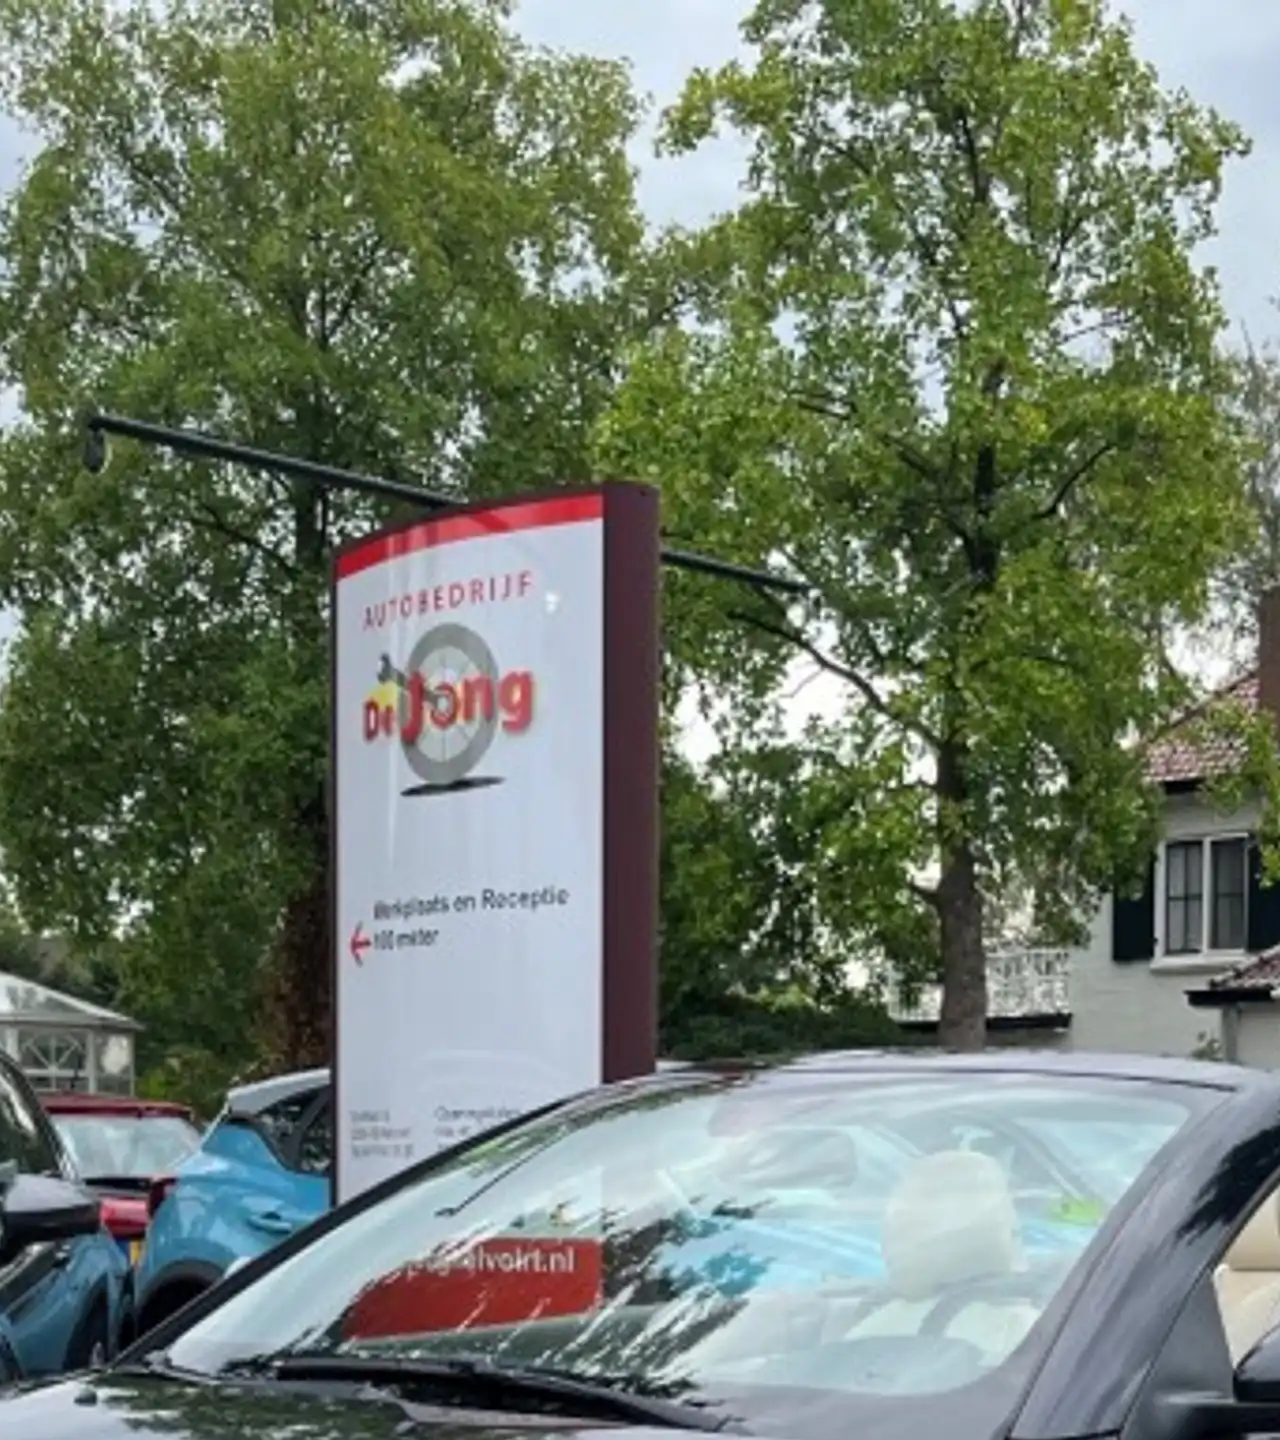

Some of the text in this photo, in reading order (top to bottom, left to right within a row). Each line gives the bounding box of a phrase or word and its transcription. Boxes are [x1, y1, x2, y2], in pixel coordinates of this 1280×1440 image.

[363, 571, 532, 633] AUTOBEDRIJF
[400, 670, 535, 745] Jong
[453, 894, 476, 912] en
[481, 885, 570, 911] Receptie
